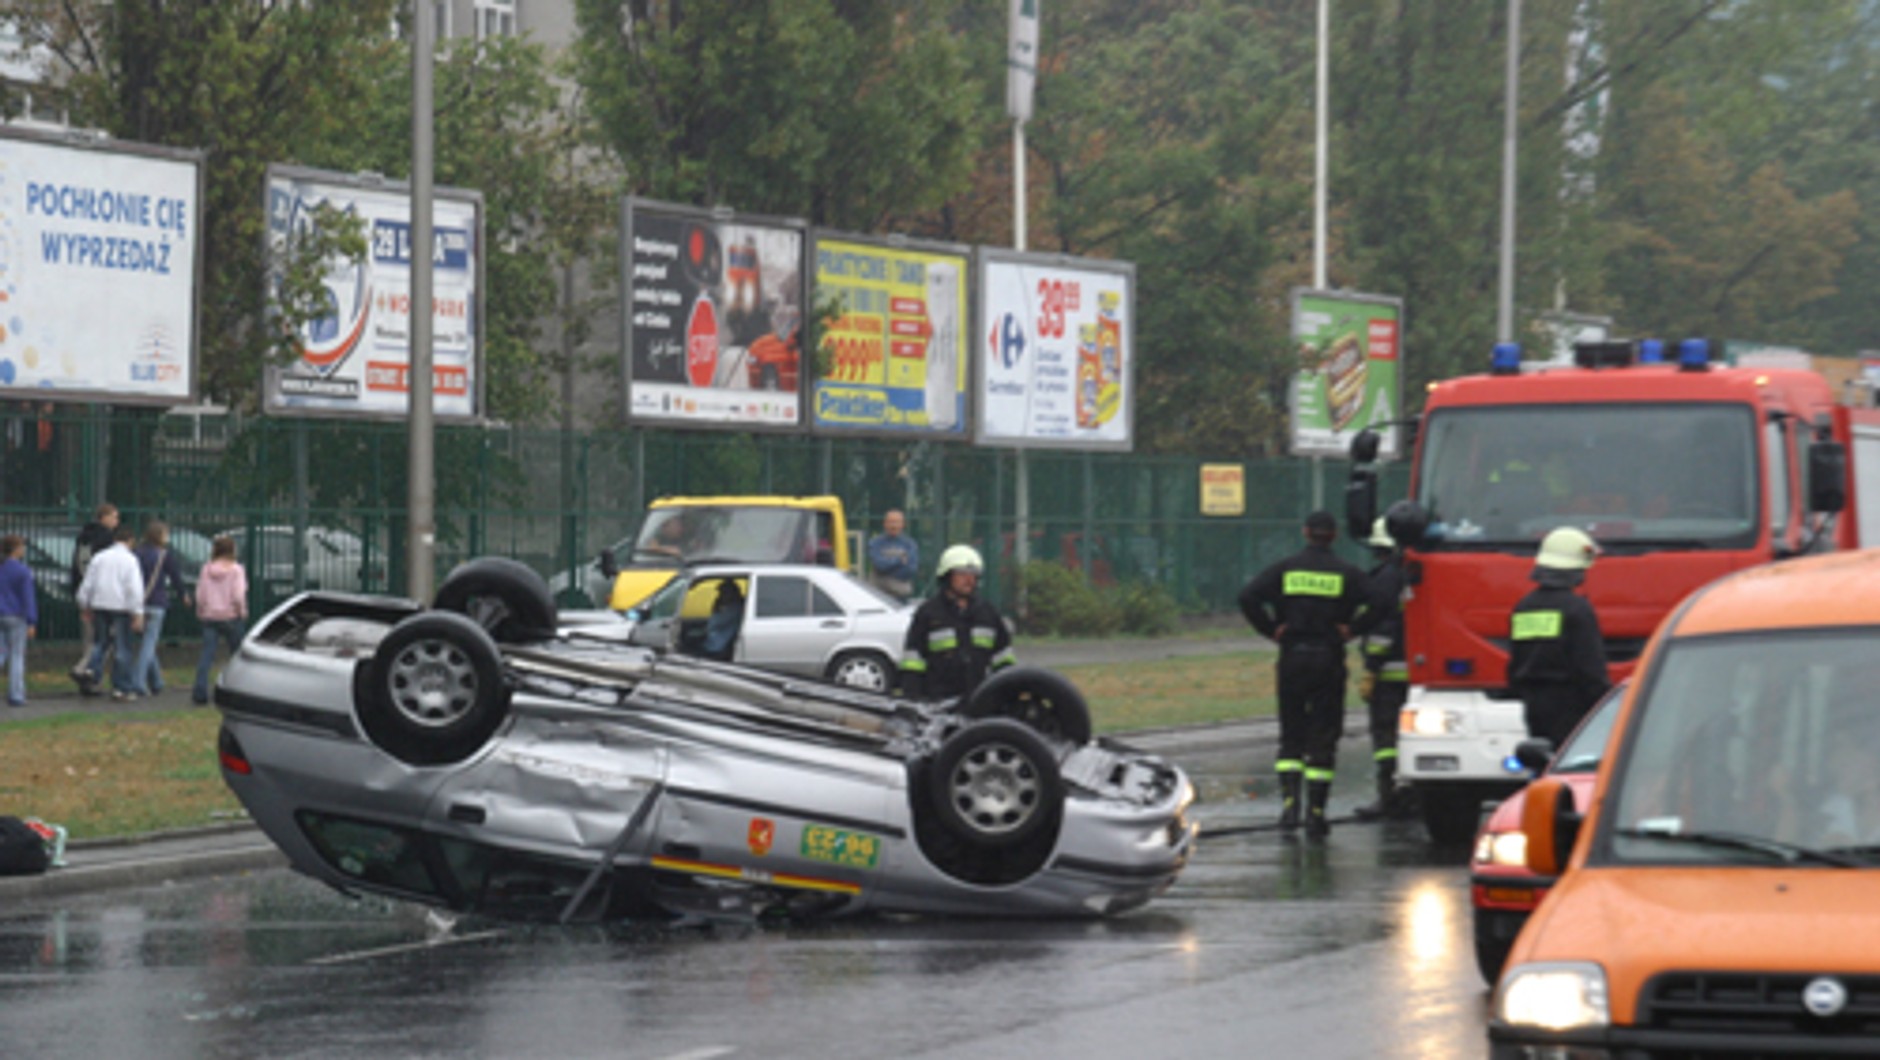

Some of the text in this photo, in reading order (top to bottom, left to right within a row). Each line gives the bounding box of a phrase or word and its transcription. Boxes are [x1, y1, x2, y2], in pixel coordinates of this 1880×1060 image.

[26, 182, 186, 240] POCHŁONIE CIĘ
[41, 230, 171, 275] WYPRZEDAŻ
[376, 227, 395, 257] 29
[1037, 278, 1064, 340] 39
